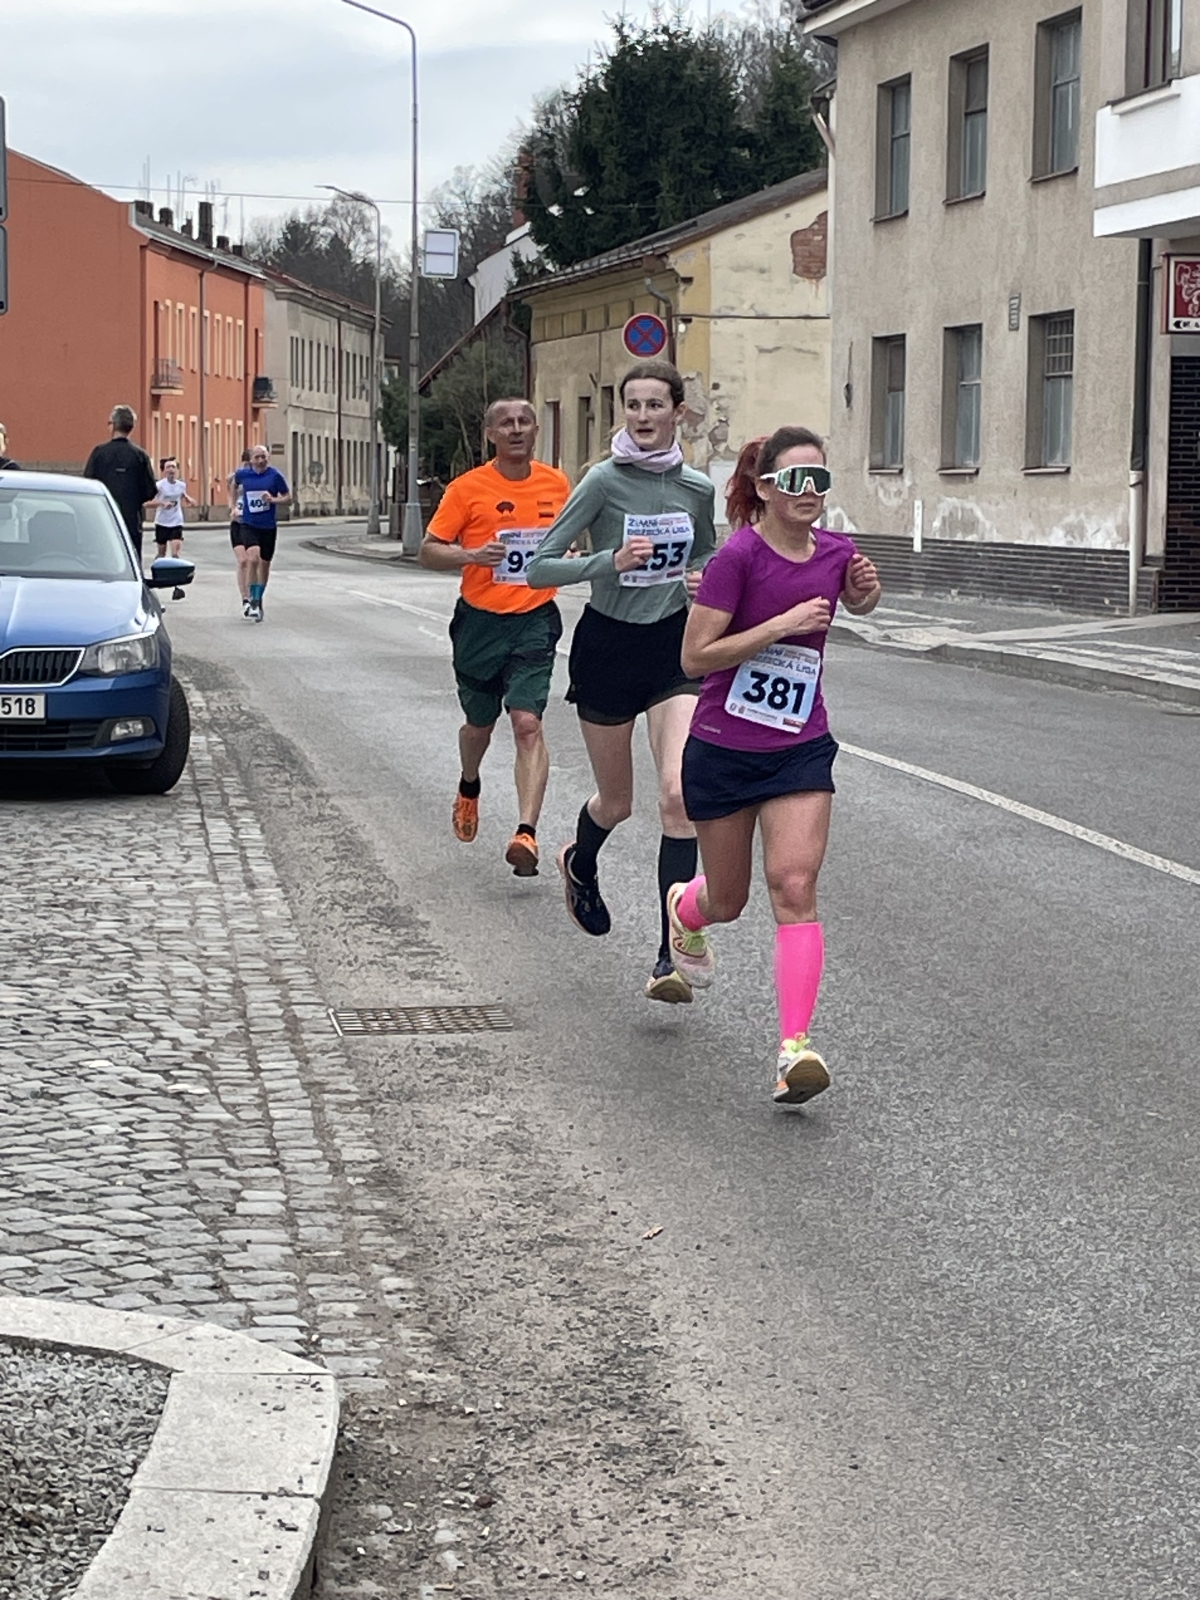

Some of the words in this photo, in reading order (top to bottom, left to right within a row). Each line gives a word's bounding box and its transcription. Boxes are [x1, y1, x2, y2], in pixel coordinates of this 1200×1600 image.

[635, 541, 688, 571] 53
[1, 696, 36, 716] 518
[742, 670, 807, 715] 381
